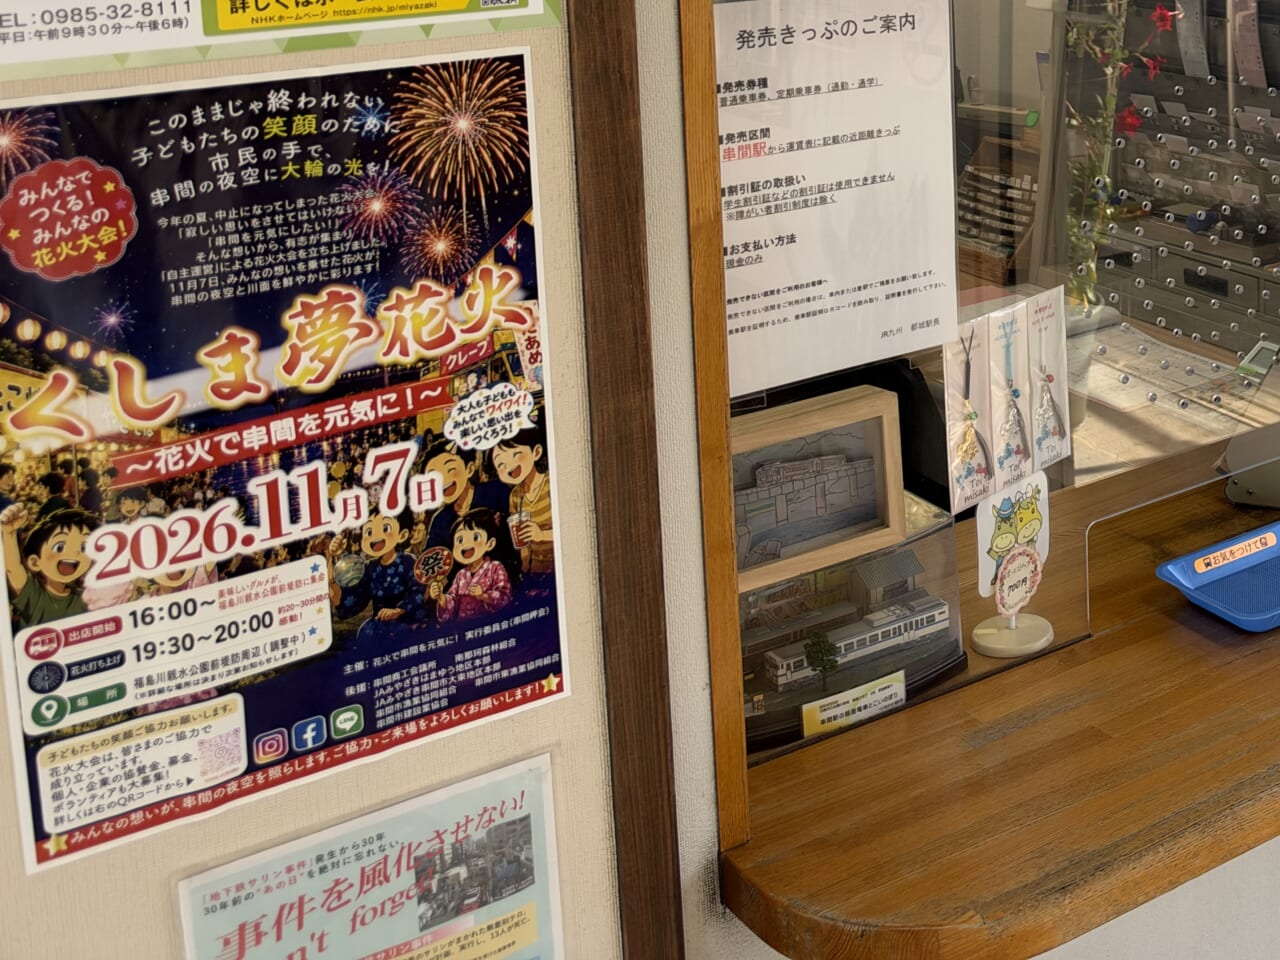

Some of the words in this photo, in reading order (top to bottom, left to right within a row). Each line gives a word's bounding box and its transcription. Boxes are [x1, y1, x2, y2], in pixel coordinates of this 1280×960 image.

[735, 12, 917, 51] 発売きっぷのご案内
[148, 88, 385, 135] このままじゃ終われない
[131, 114, 401, 167] 子どもたちの笑顔のために
[18, 170, 93, 207] みんなで
[32, 207, 110, 245] みんなの
[725, 253, 764, 269] 現金のみ
[445, 338, 490, 371] クレープ
[456, 388, 516, 415] 大人も子どもも
[459, 410, 522, 439] 楽しい思い出を
[420, 552, 445, 576] 祭
[1212, 537, 1260, 566] お気をつけて
[68, 620, 117, 642] 出店開始
